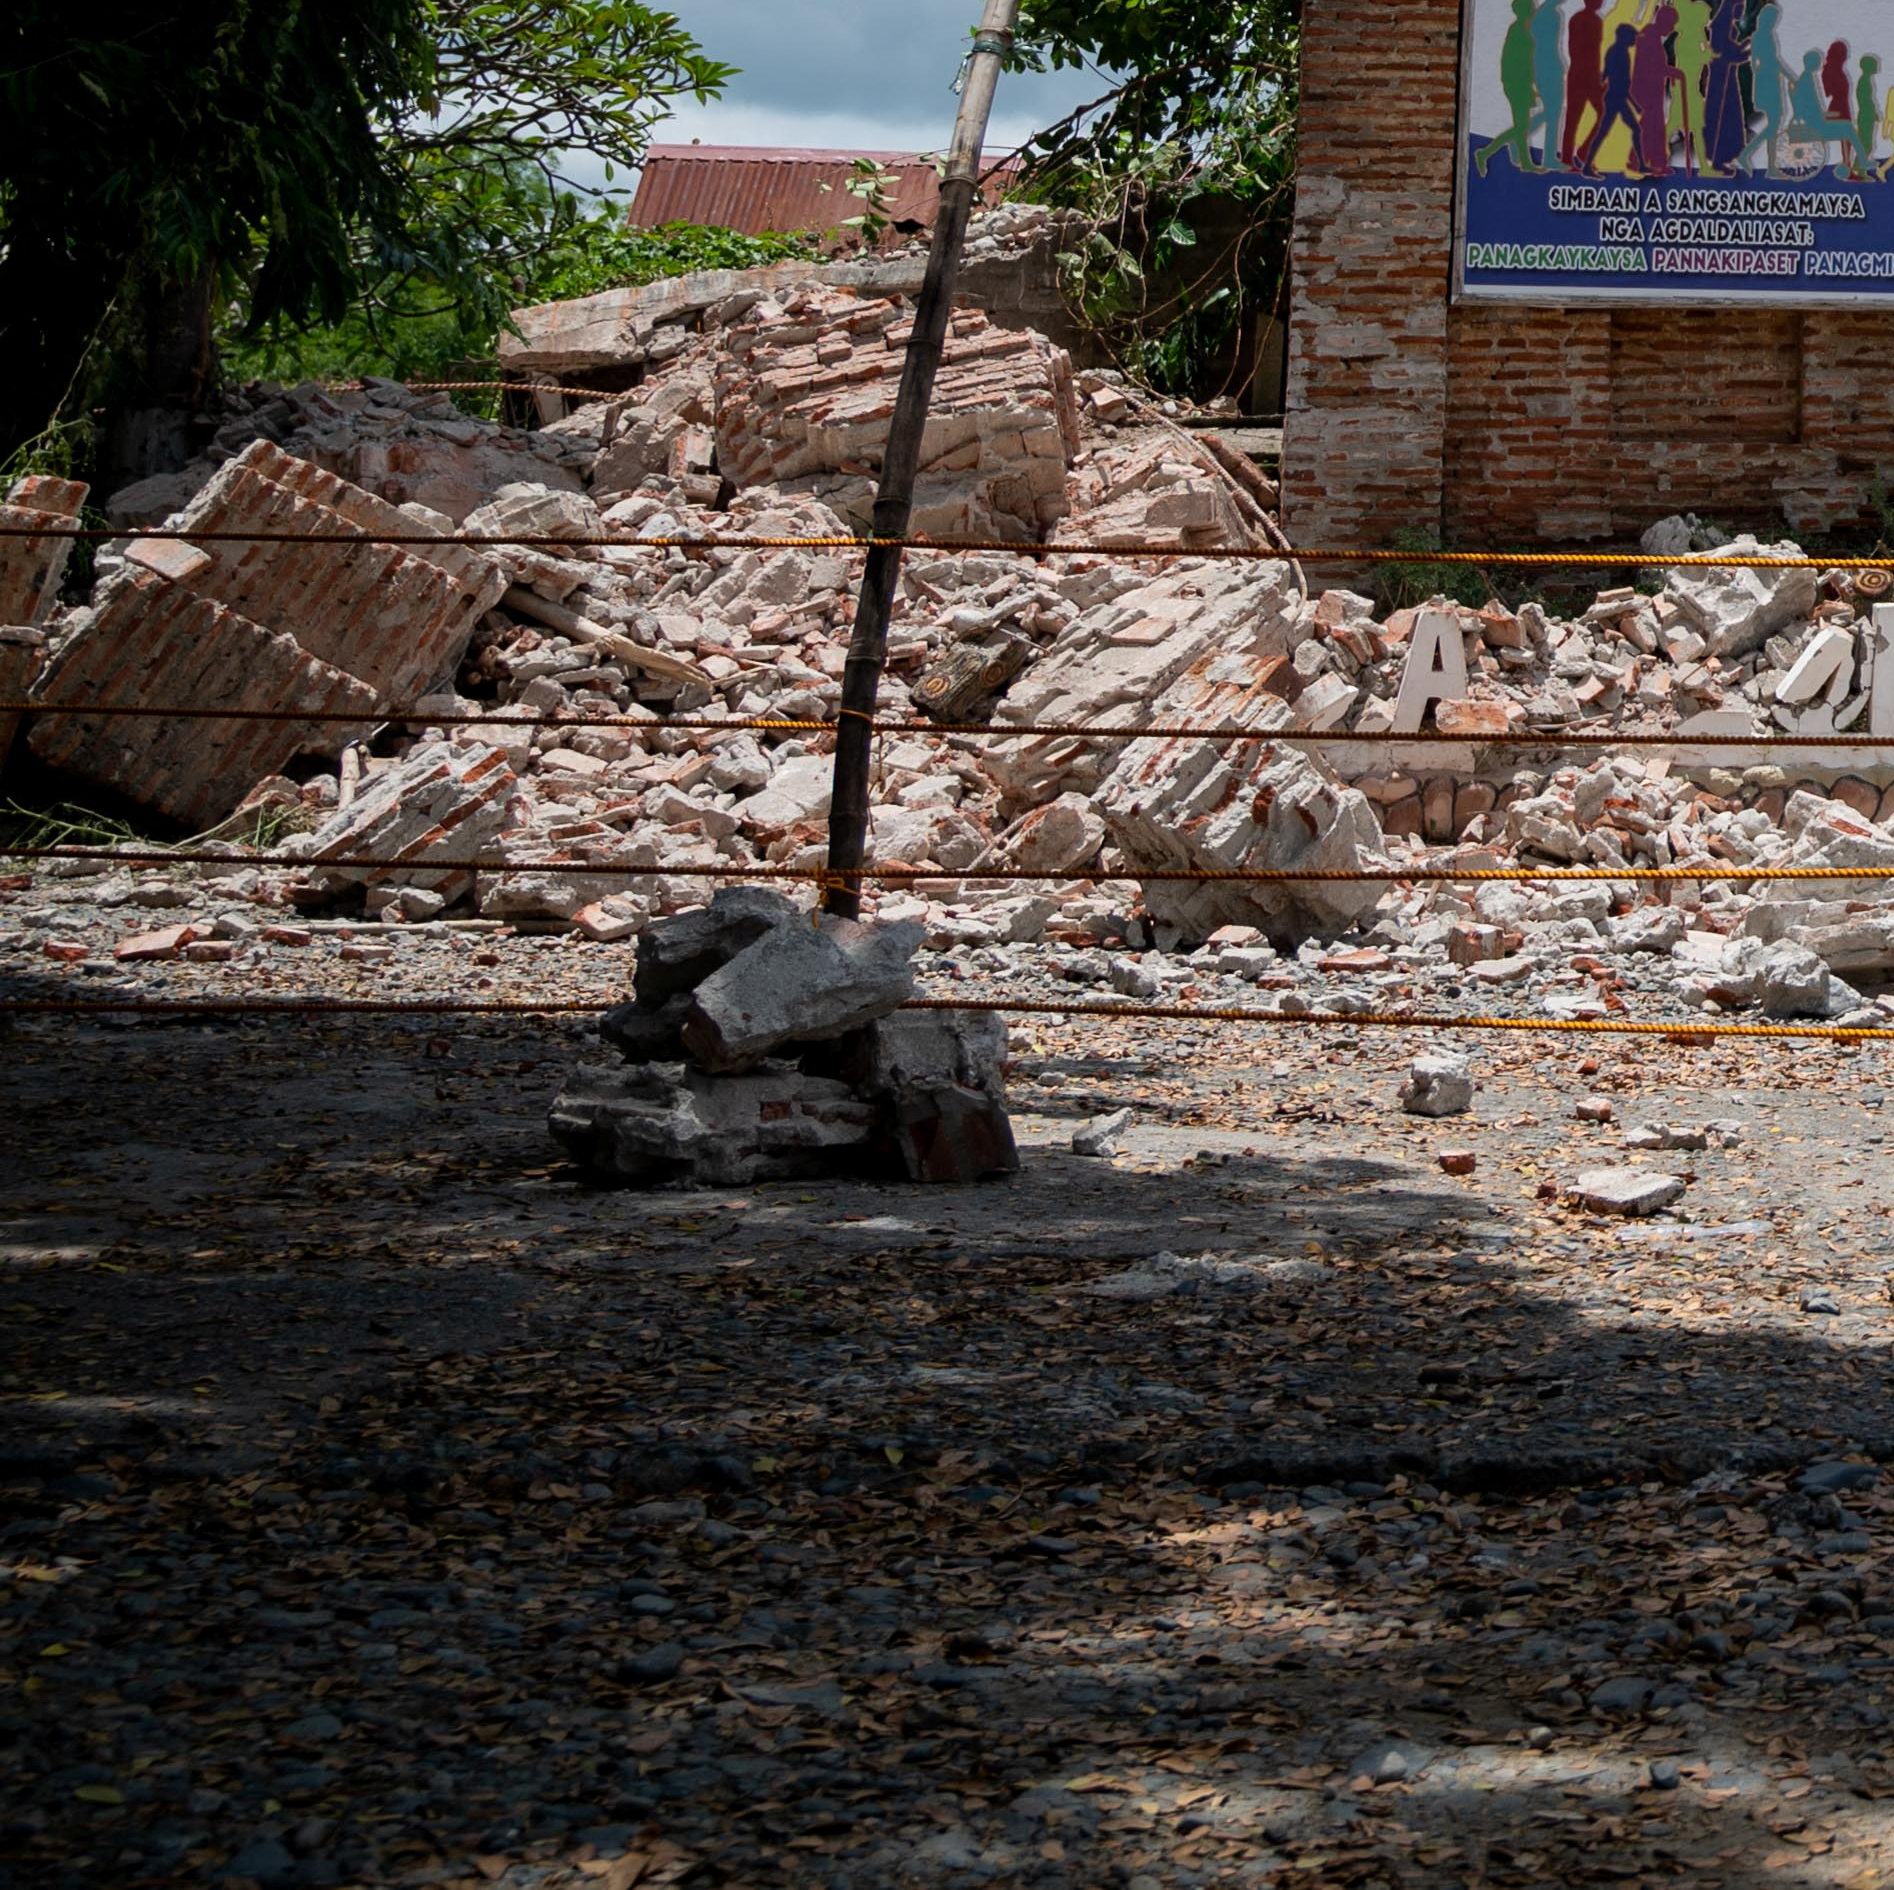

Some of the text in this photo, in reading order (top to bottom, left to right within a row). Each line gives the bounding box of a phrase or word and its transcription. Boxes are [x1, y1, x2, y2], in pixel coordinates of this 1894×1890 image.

[1549, 185, 1866, 219] SIMBAAN A SANGSANGKAMAYSA
[1599, 216, 1815, 246] NGA AGDALDALIASAT:
[1466, 242, 1649, 272] PANAGKAYKAYSA
[1652, 247, 1801, 275] PANNAKIPASET
